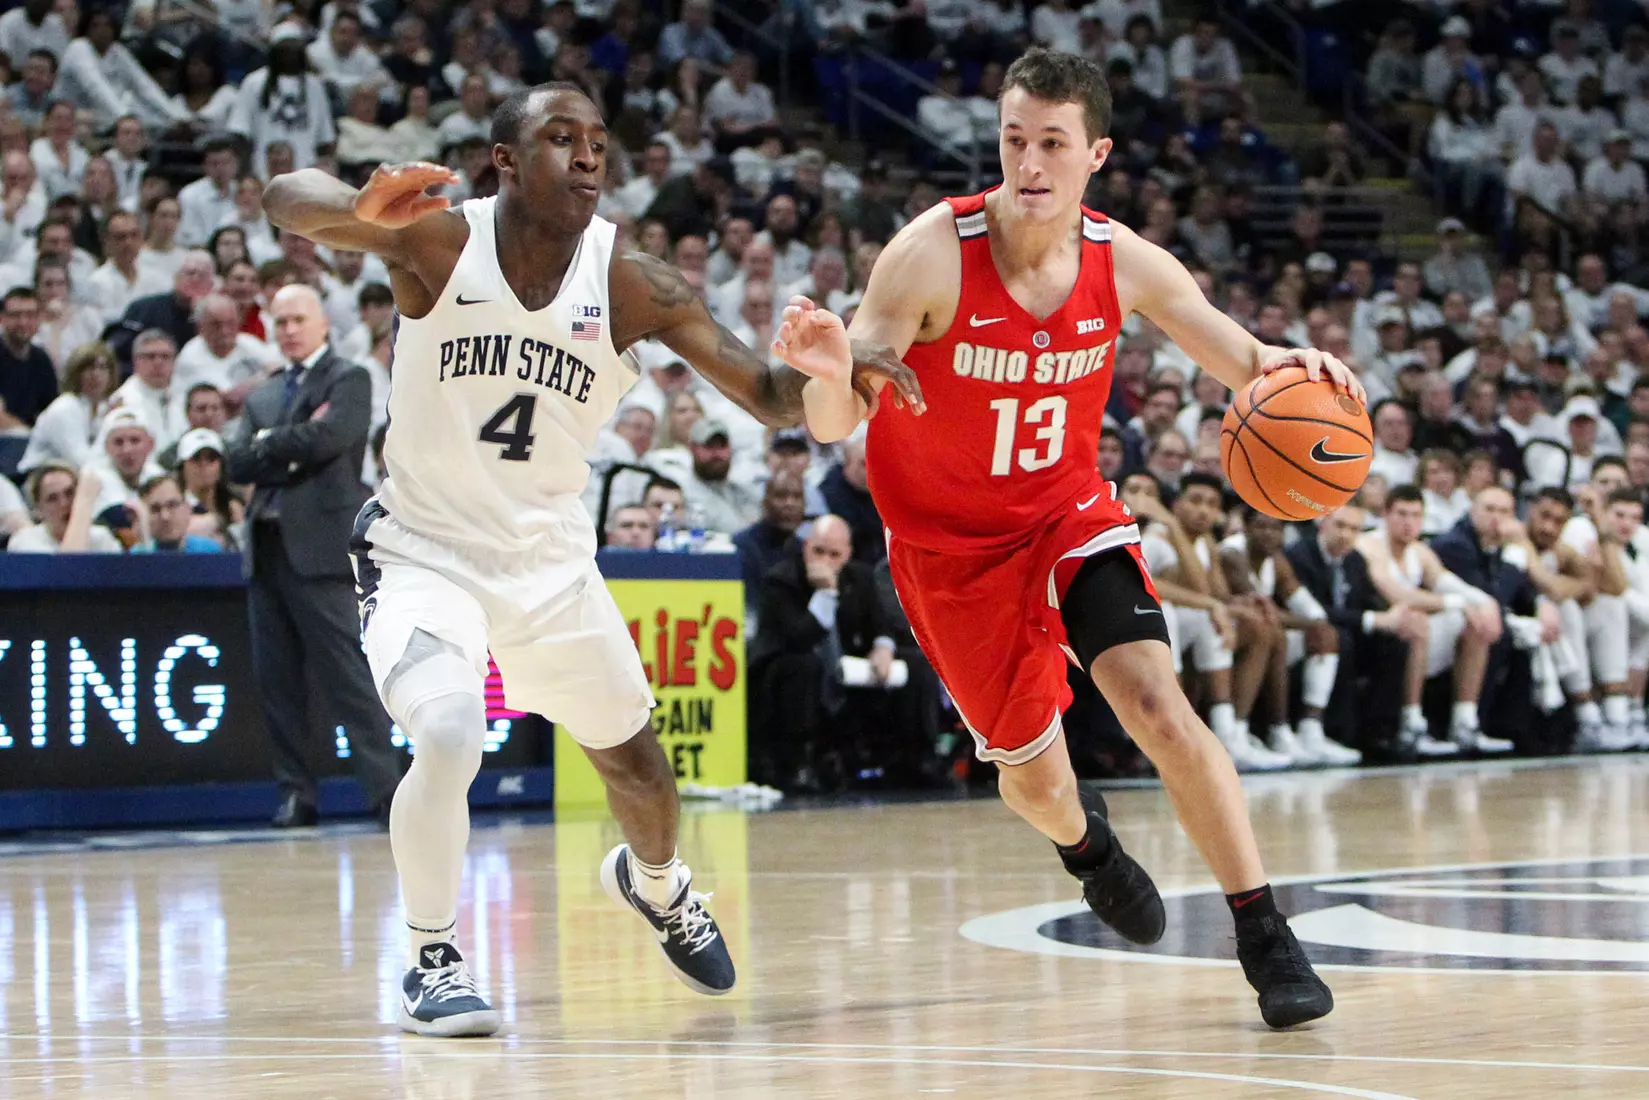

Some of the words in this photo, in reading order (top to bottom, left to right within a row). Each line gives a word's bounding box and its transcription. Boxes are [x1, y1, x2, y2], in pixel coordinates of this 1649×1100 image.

[439, 334, 512, 382] PENN
[517, 337, 596, 404] STATE
[953, 341, 1029, 384] OHIO
[1032, 339, 1112, 385] STATE
[477, 391, 539, 462] 4
[989, 395, 1068, 476] 13
